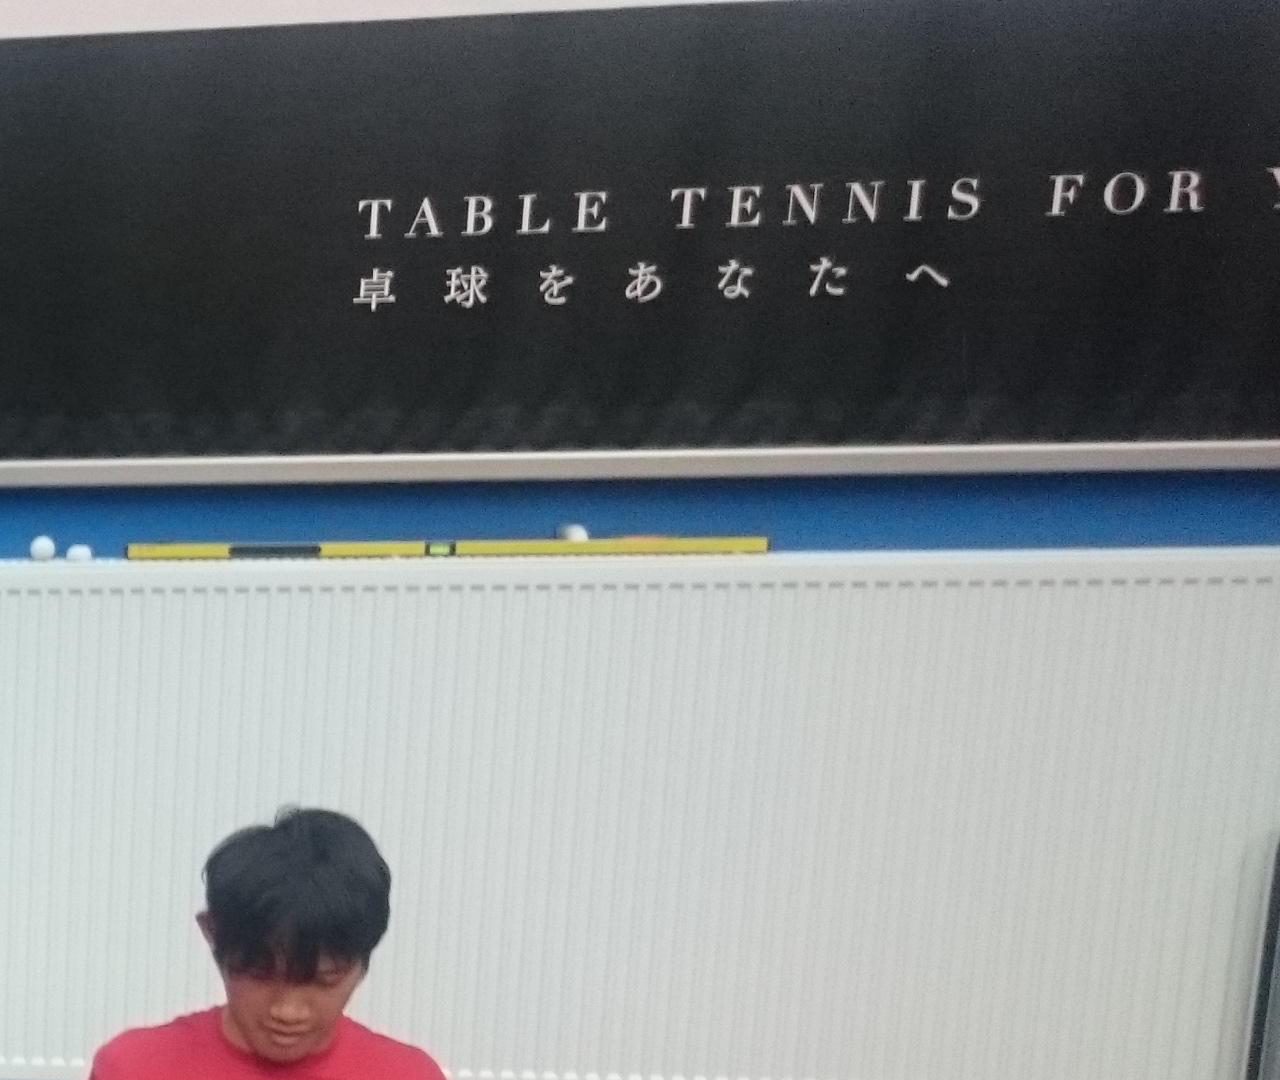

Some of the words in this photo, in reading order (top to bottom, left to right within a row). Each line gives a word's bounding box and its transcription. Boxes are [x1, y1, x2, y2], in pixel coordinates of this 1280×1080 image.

[357, 190, 609, 241] TABLE
[670, 175, 982, 230] TENNIS
[1044, 169, 1206, 218] FOR
[352, 256, 951, 313] 卓球をあなたへ
